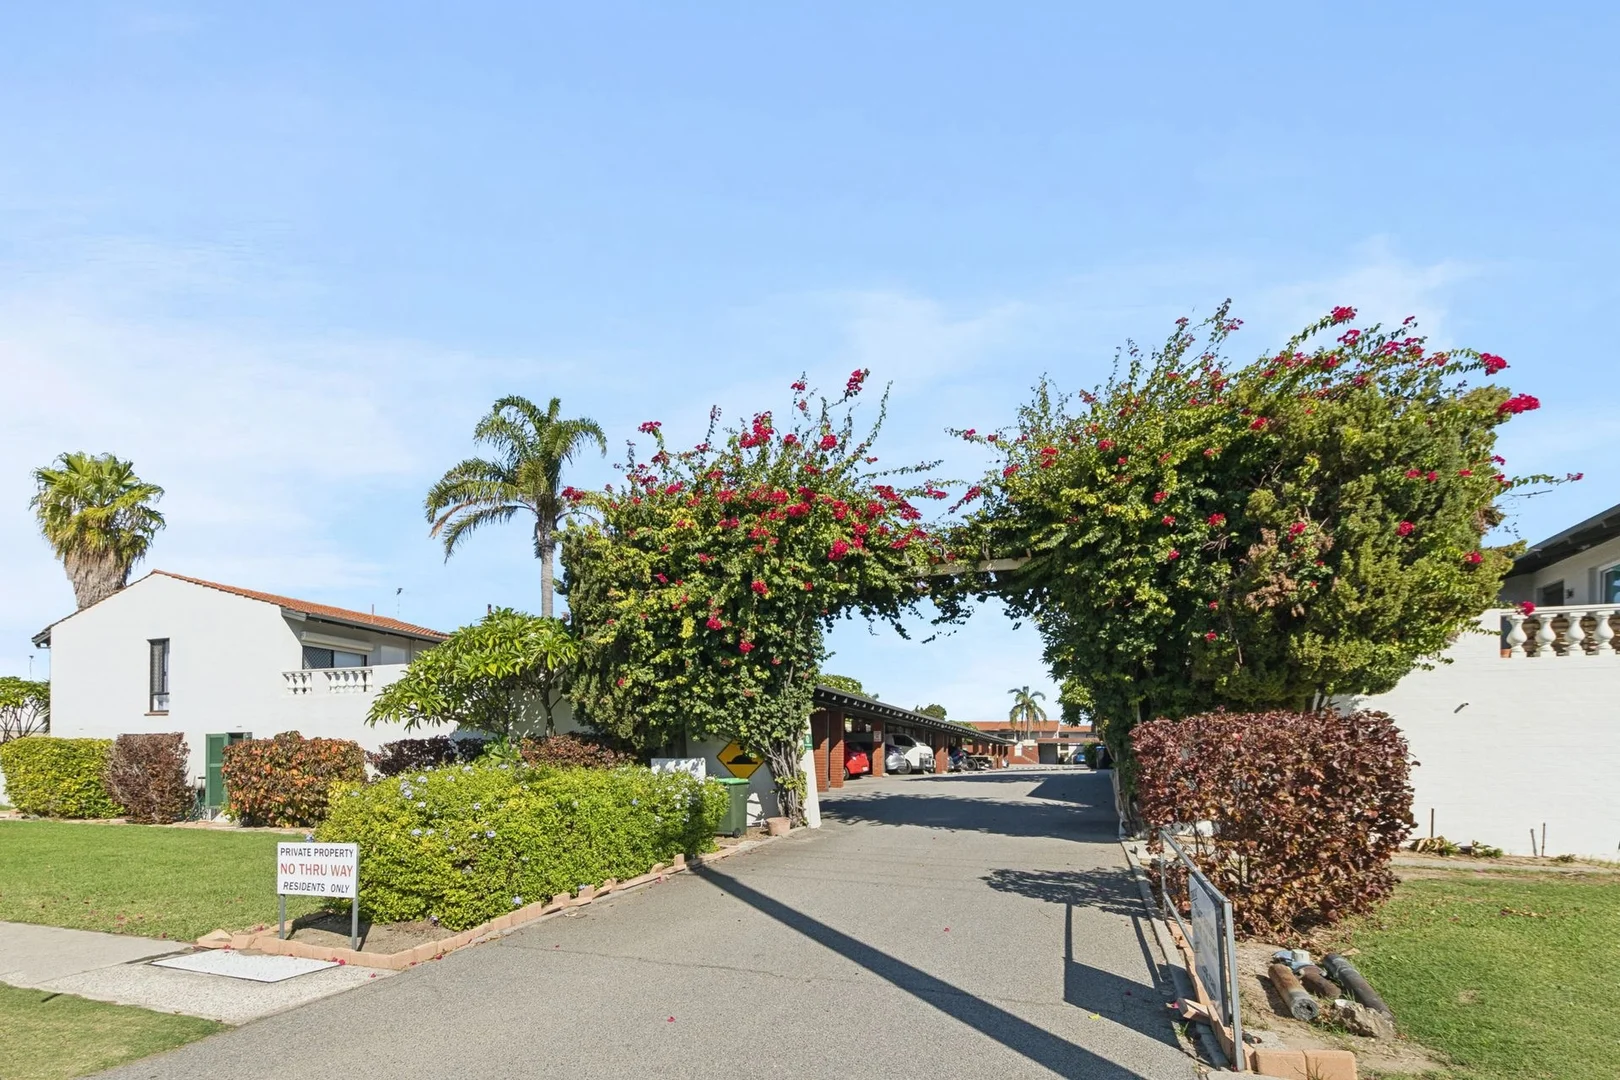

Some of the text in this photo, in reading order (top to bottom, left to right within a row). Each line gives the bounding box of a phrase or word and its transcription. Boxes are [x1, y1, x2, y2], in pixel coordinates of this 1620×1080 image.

[280, 847, 354, 858] PRIVATE PROPERTY
[280, 863, 353, 877] NO THRU WAY
[283, 881, 350, 893] RESIDENTS ONLY
